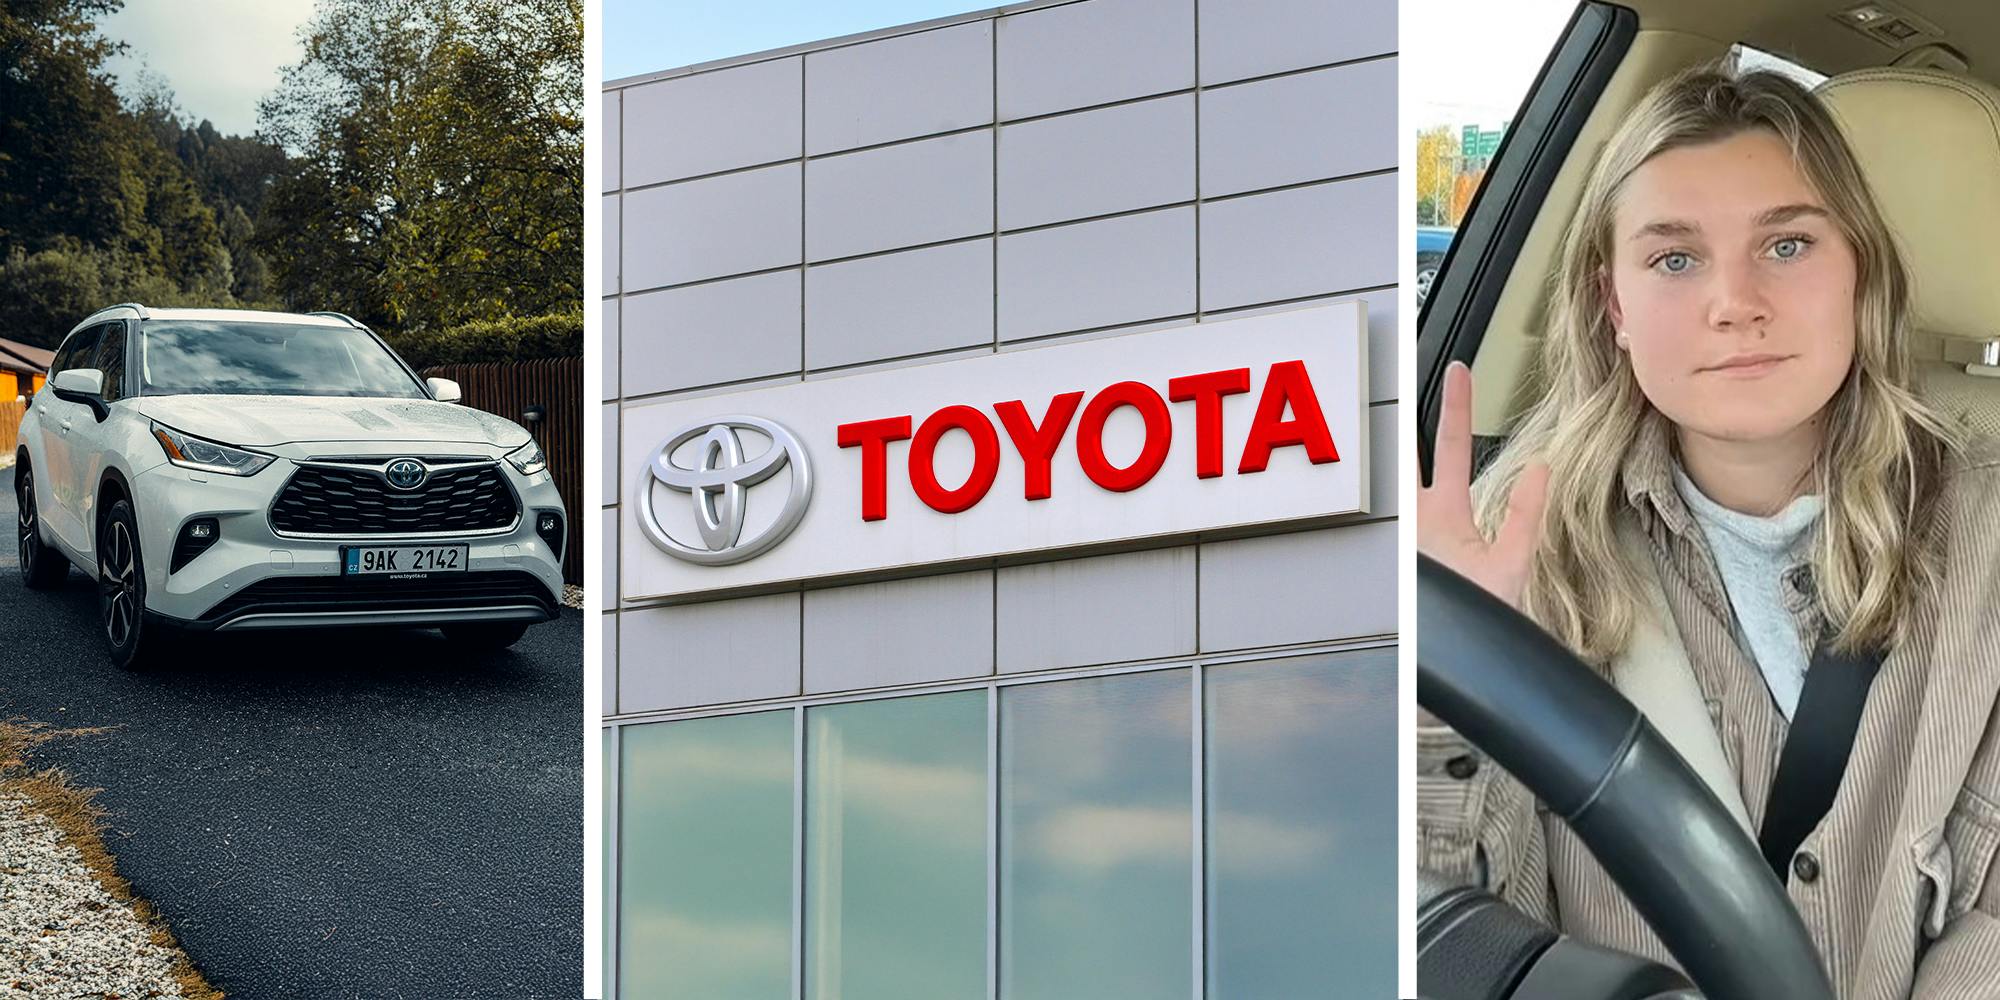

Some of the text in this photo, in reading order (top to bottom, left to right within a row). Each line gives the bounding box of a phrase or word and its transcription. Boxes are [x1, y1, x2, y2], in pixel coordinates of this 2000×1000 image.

[837, 360, 1340, 521] TOYOTA
[363, 549, 458, 571] 9AK 2142
